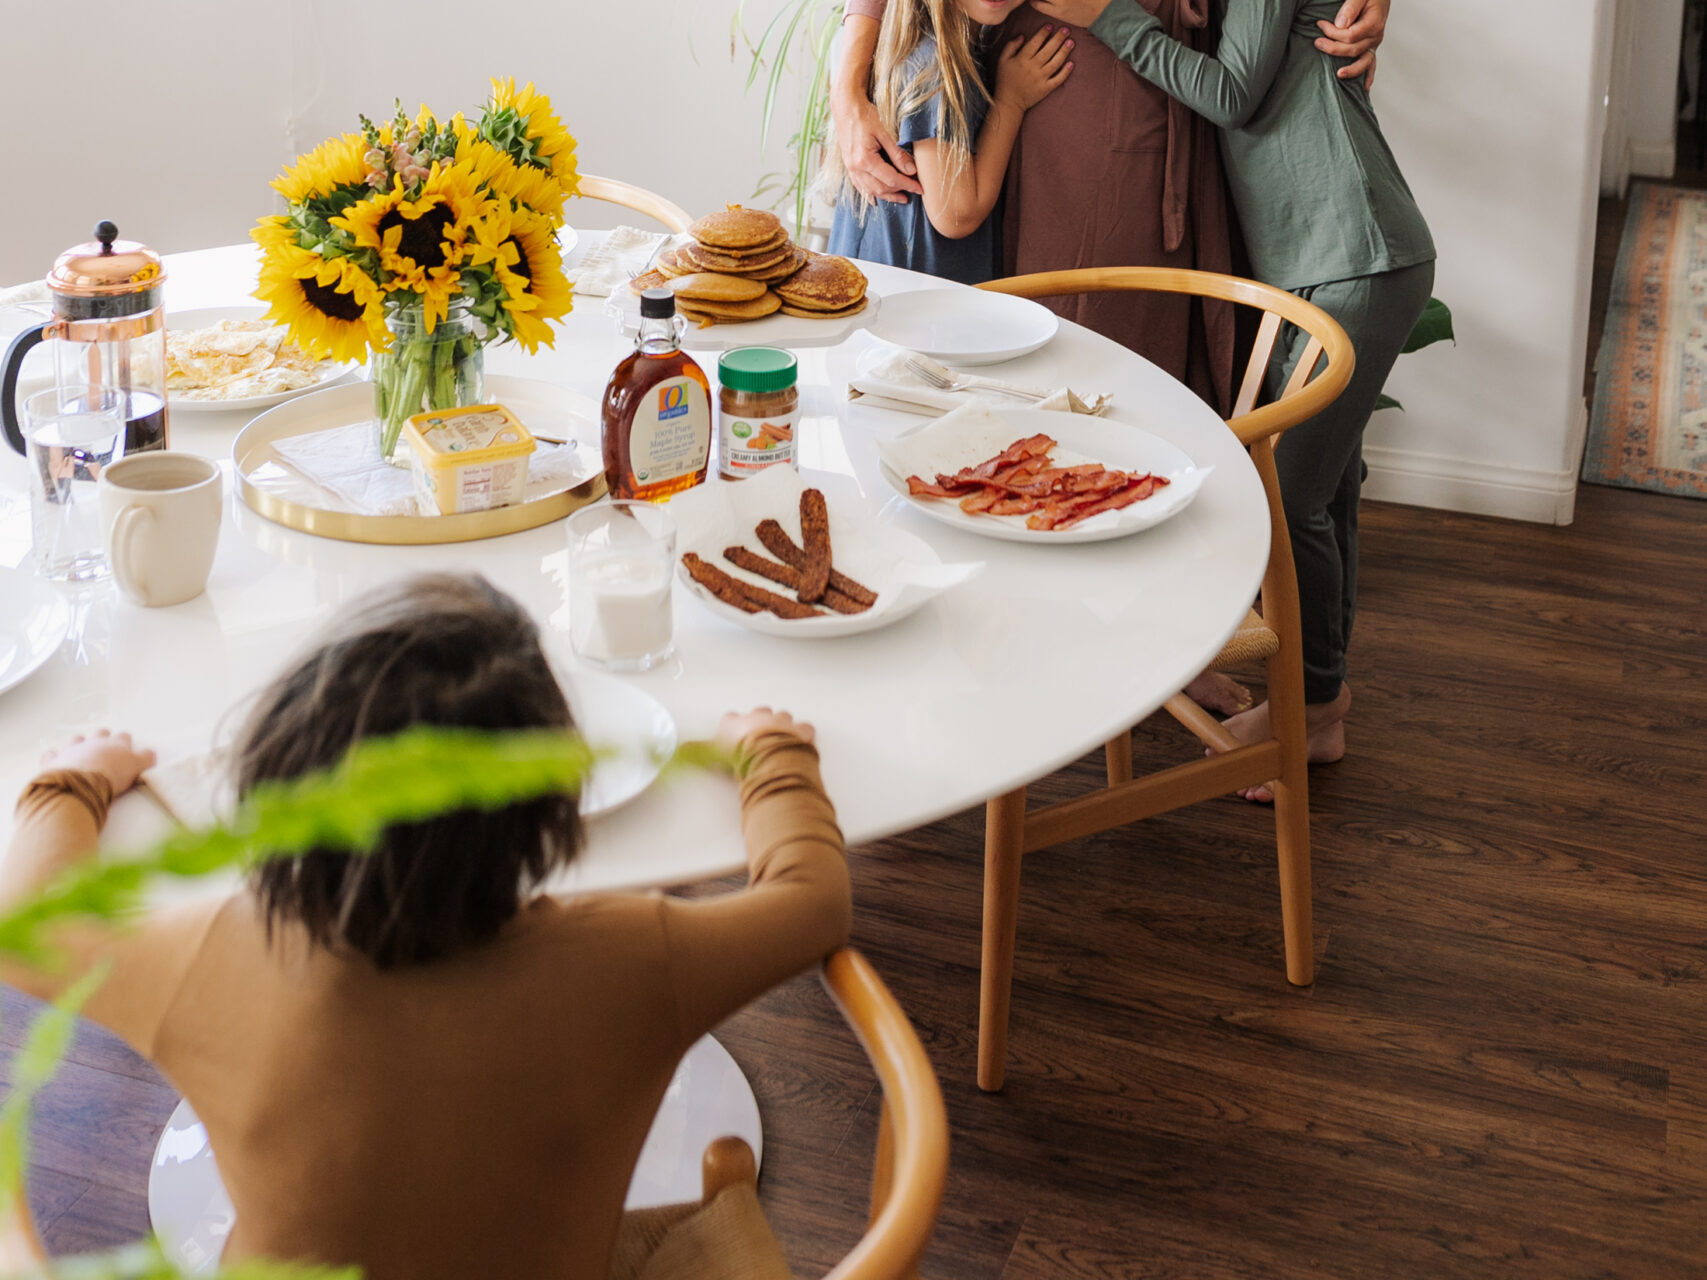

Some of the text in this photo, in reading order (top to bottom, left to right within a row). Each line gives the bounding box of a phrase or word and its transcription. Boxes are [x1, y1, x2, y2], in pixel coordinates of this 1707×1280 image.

[675, 424, 692, 434] Pure
[650, 437, 673, 449] Maple
[675, 432, 696, 443] Syrup
[731, 449, 791, 462] CREAMY ALMOND BUTTER
